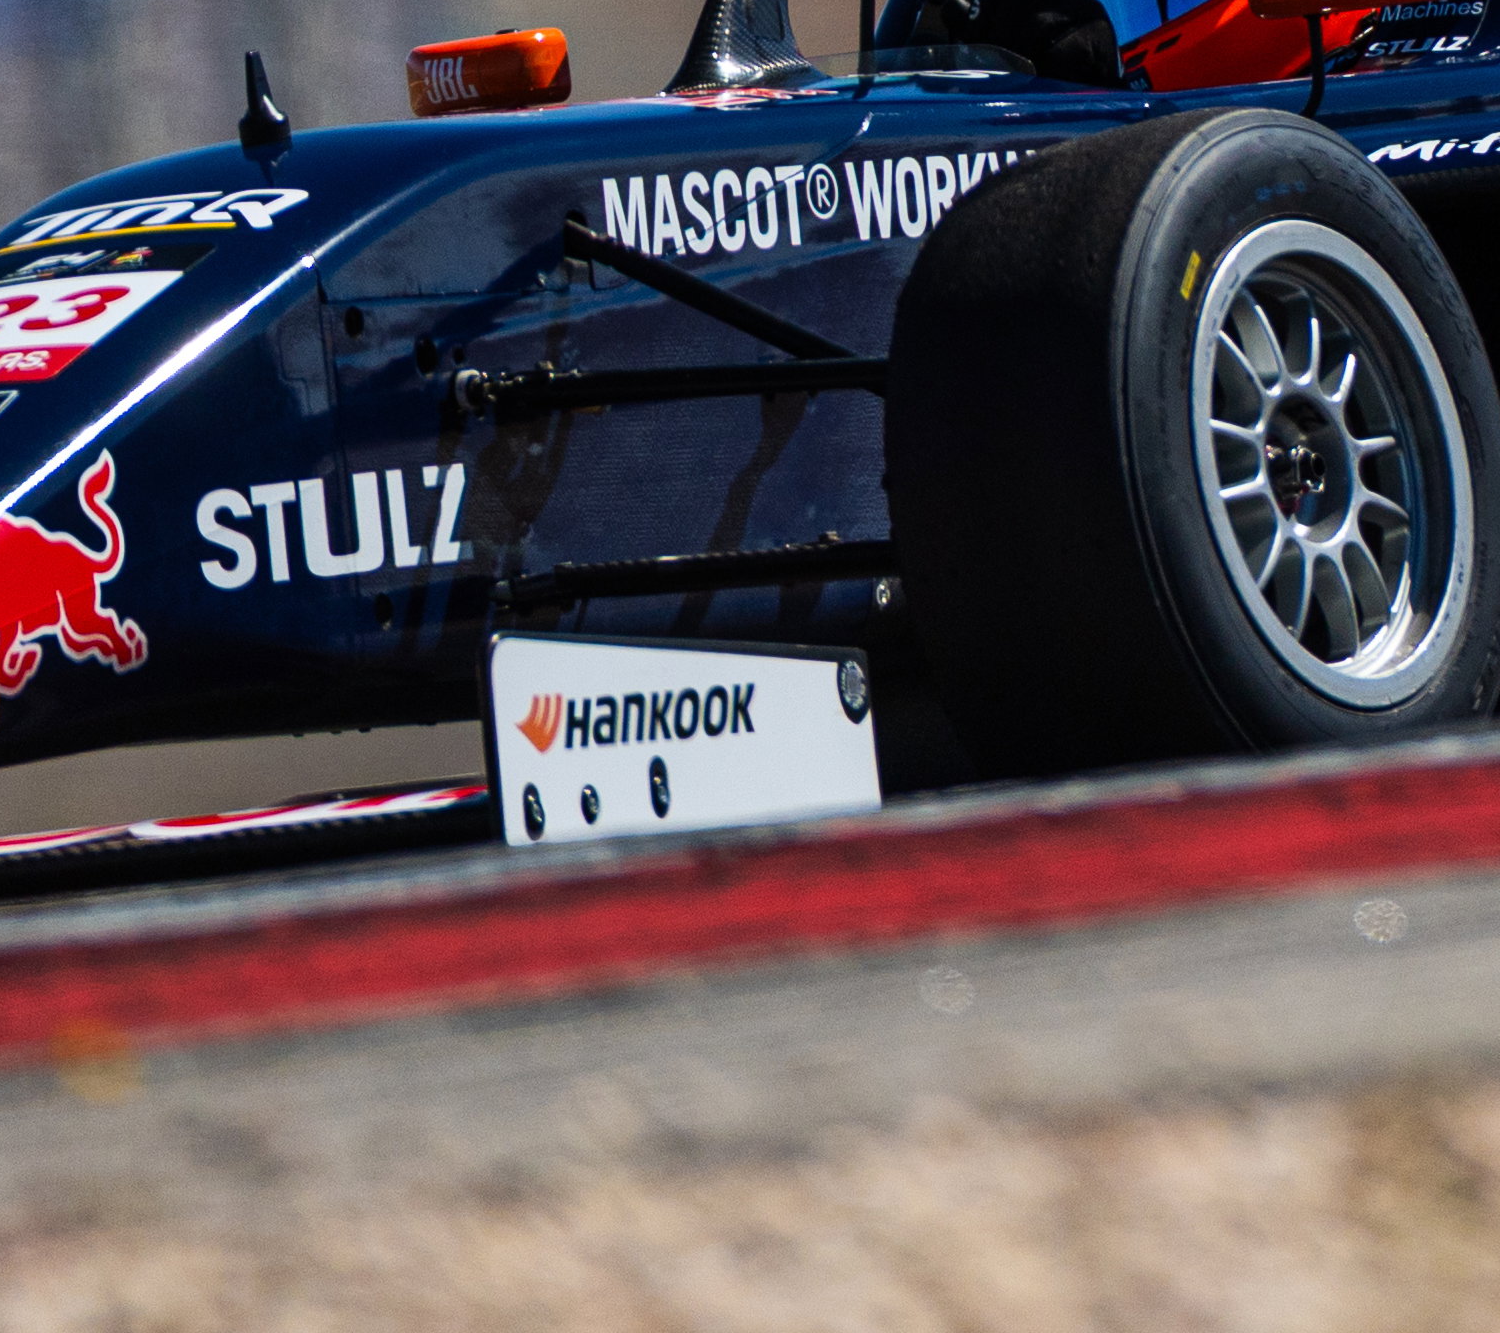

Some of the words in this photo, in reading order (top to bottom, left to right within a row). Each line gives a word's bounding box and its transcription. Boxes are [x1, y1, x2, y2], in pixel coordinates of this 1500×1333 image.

[1381, 0, 1484, 22] Machines
[1364, 35, 1470, 58] STULZ
[424, 56, 480, 104] JBL
[8, 188, 309, 245] TinQ
[196, 462, 474, 591] STULZ
